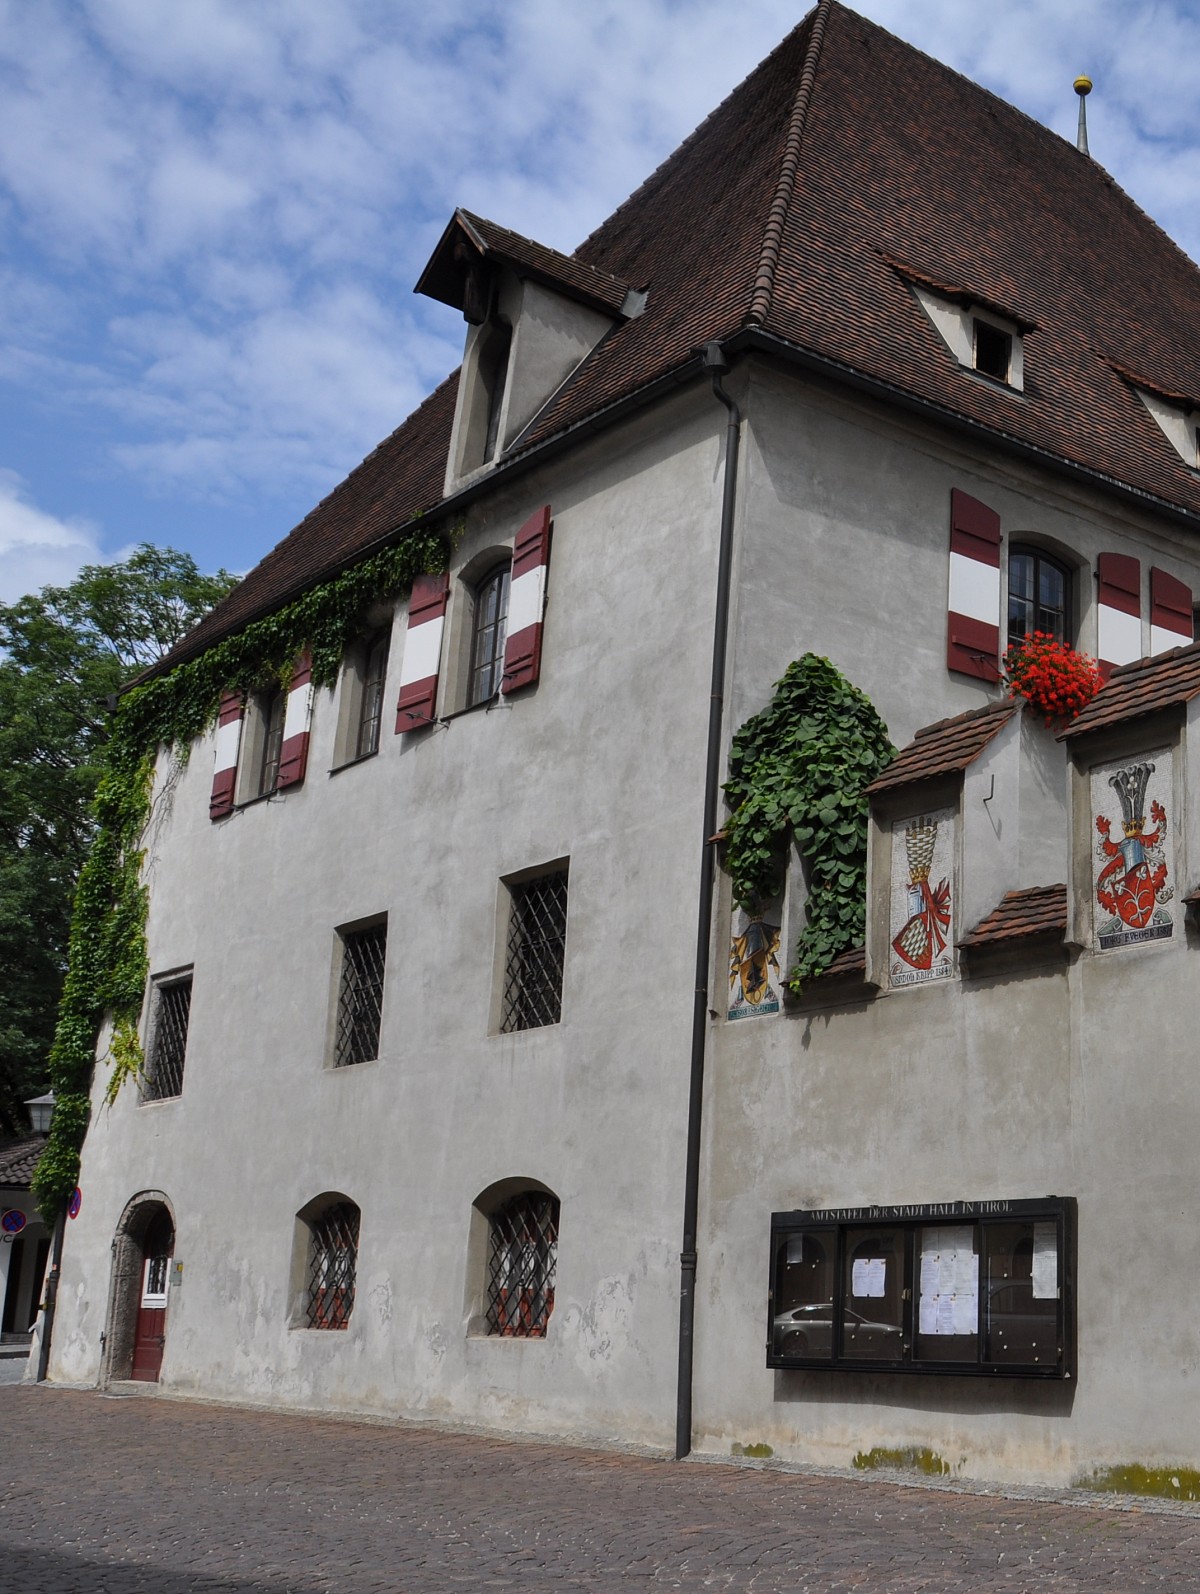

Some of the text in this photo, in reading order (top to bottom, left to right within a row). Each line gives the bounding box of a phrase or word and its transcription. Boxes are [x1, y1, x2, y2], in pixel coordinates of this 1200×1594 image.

[811, 1200, 1013, 1221] AMTSTAFEL DER STADT HALL IN TIROL
